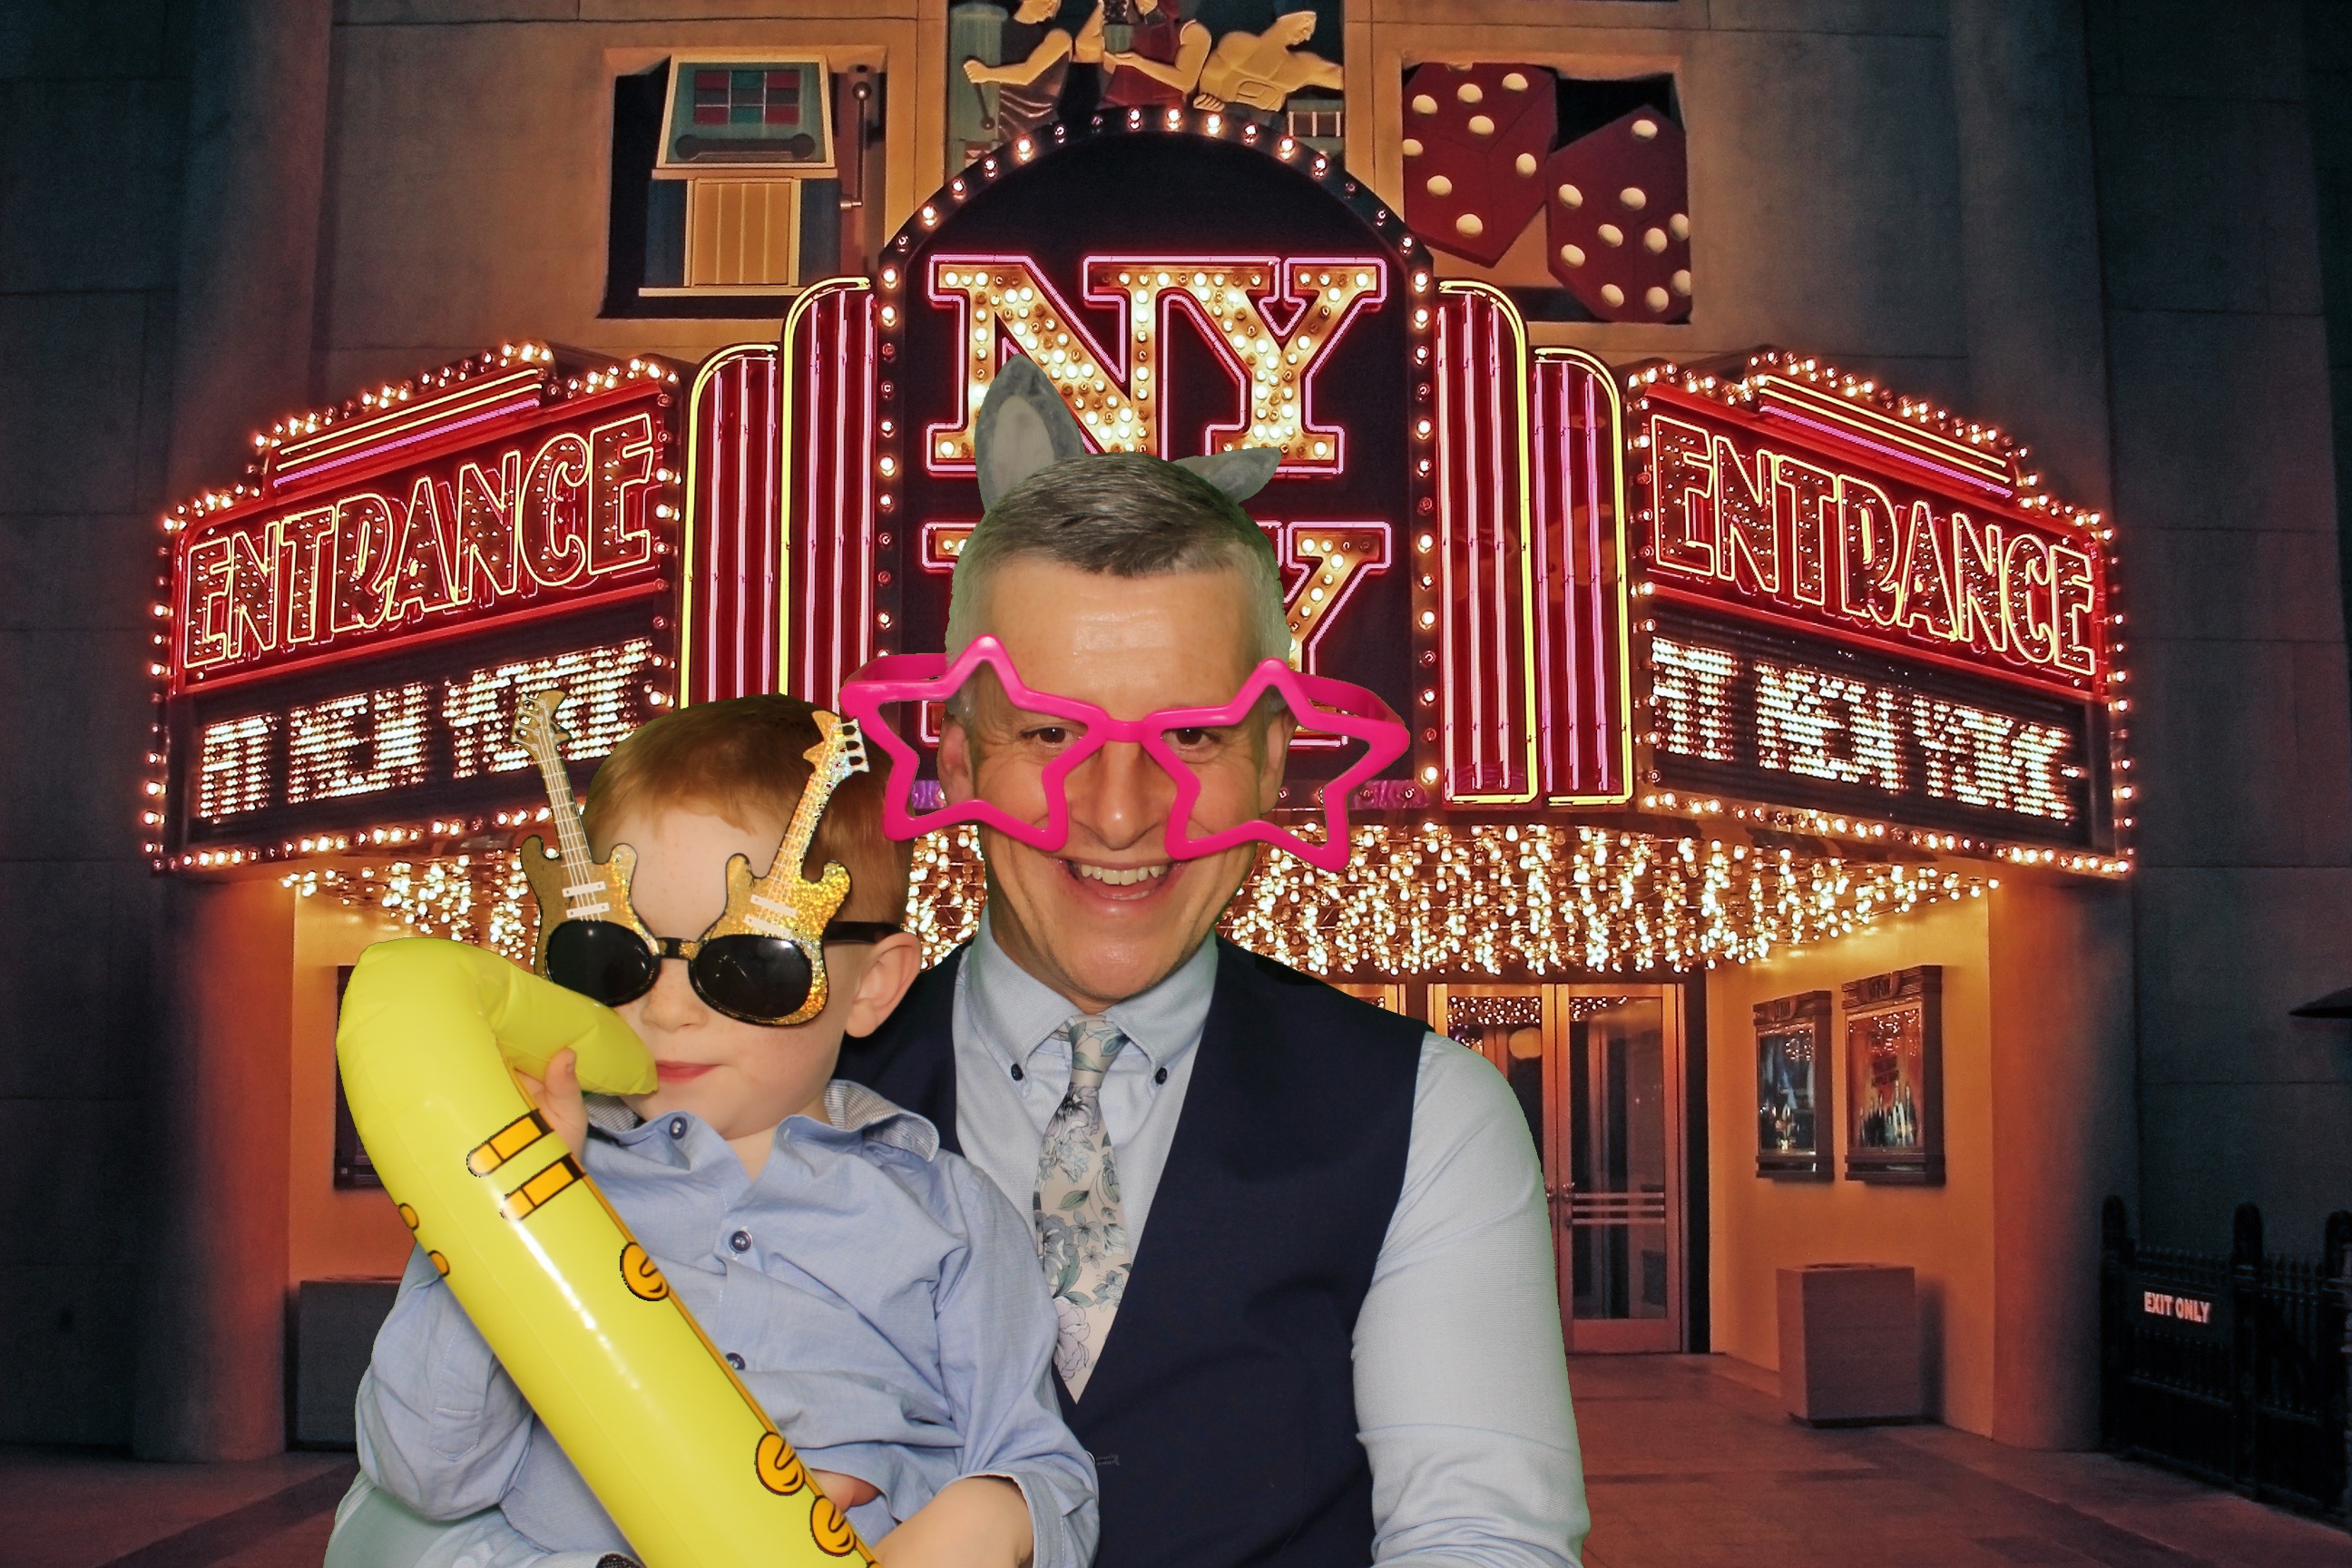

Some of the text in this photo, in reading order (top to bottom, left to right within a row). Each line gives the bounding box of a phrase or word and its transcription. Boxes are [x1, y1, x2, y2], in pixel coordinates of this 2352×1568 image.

[927, 255, 1387, 474] NY
[184, 413, 652, 669] ENTRANCE
[1651, 415, 2096, 675] ENTRANCE
[288, 682, 427, 804] NEW
[1755, 662, 1906, 792] NEW
[2144, 1291, 2211, 1324] EXIT ONLY
